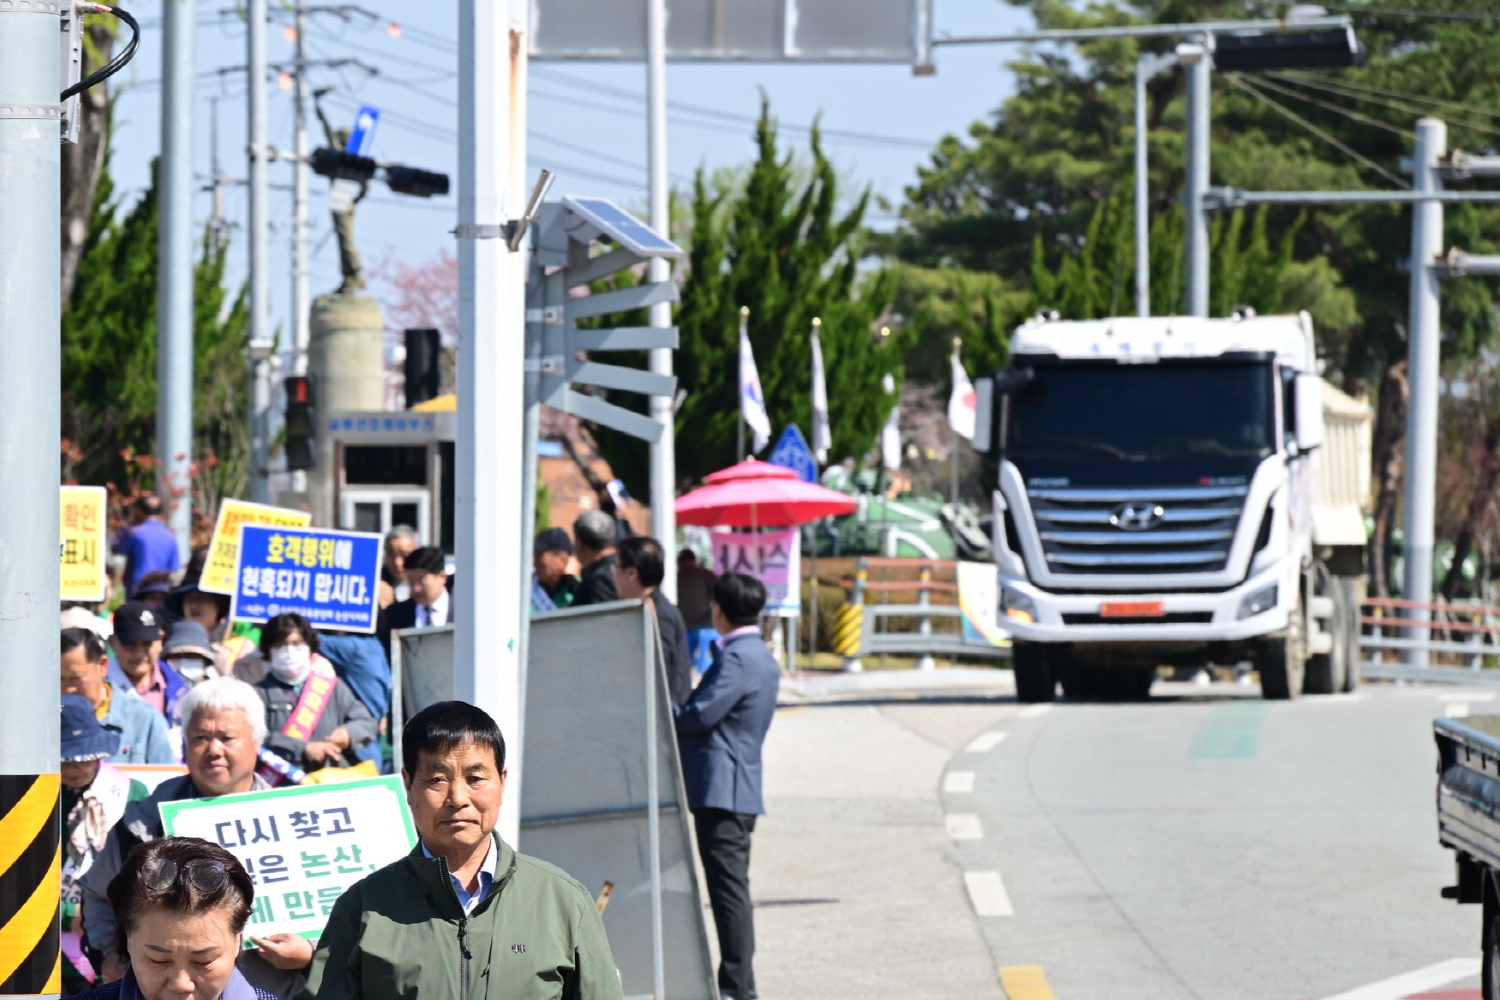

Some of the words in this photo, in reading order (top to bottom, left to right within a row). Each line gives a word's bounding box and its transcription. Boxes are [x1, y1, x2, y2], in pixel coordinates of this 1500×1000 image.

[65, 539, 97, 566] 표시
[266, 533, 353, 570] 호객행위에
[214, 815, 281, 848] 다시
[289, 807, 356, 839] 찾고
[300, 844, 375, 879] 논산,
